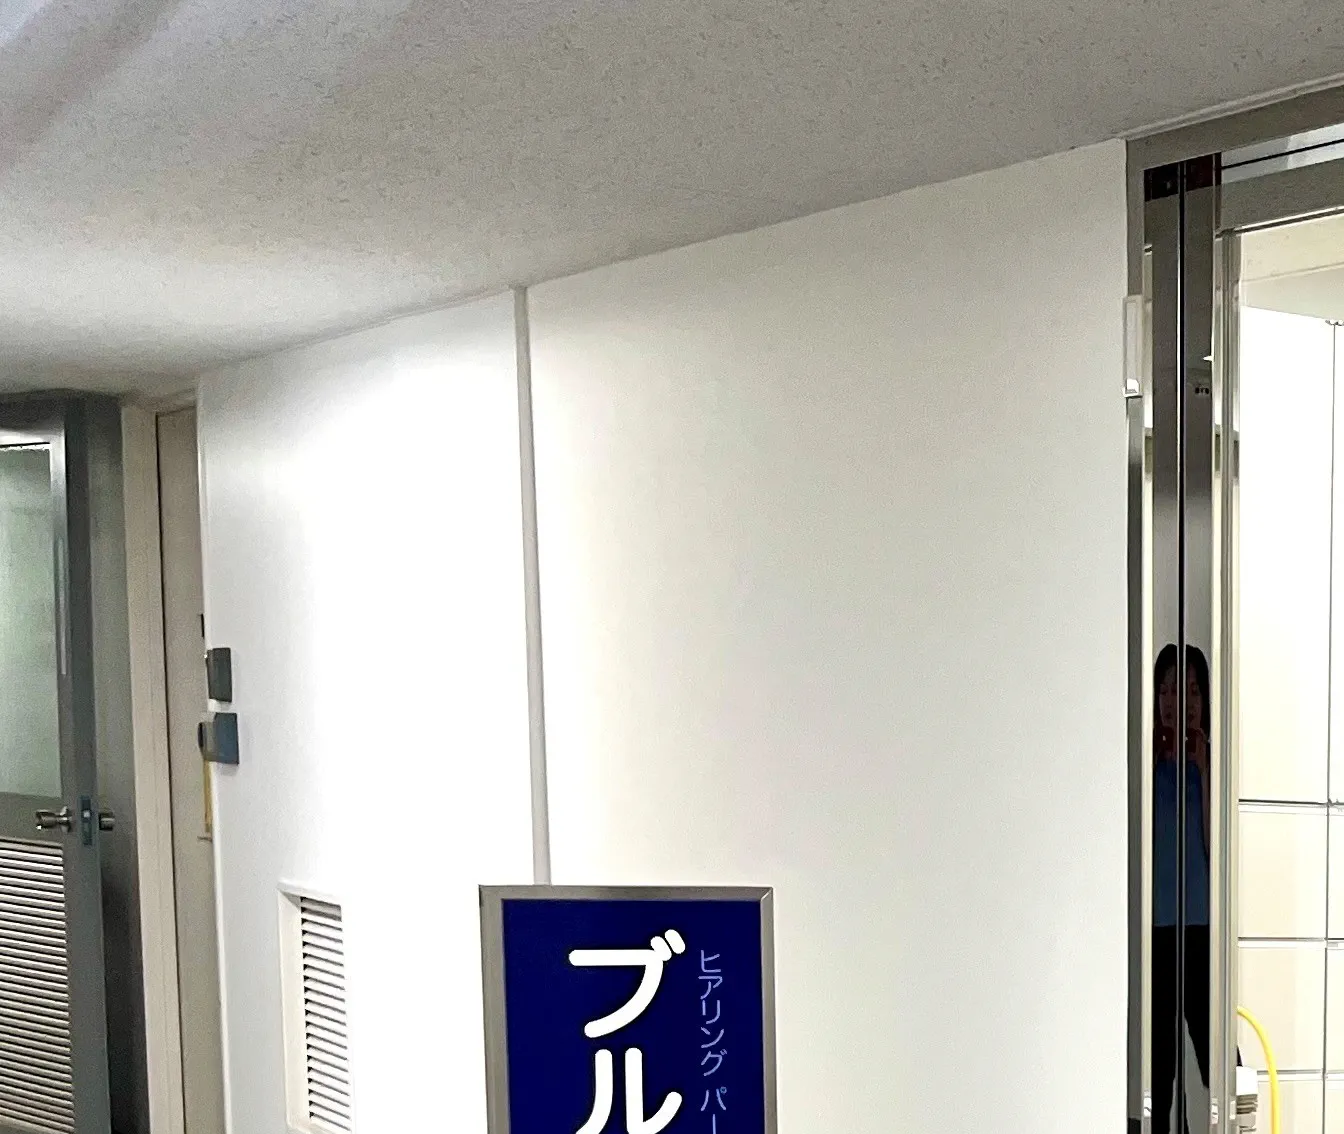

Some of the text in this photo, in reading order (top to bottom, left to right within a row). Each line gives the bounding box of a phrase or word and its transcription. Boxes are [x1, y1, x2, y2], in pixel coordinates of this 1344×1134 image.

[698, 949, 728, 1077] ヒアリング
